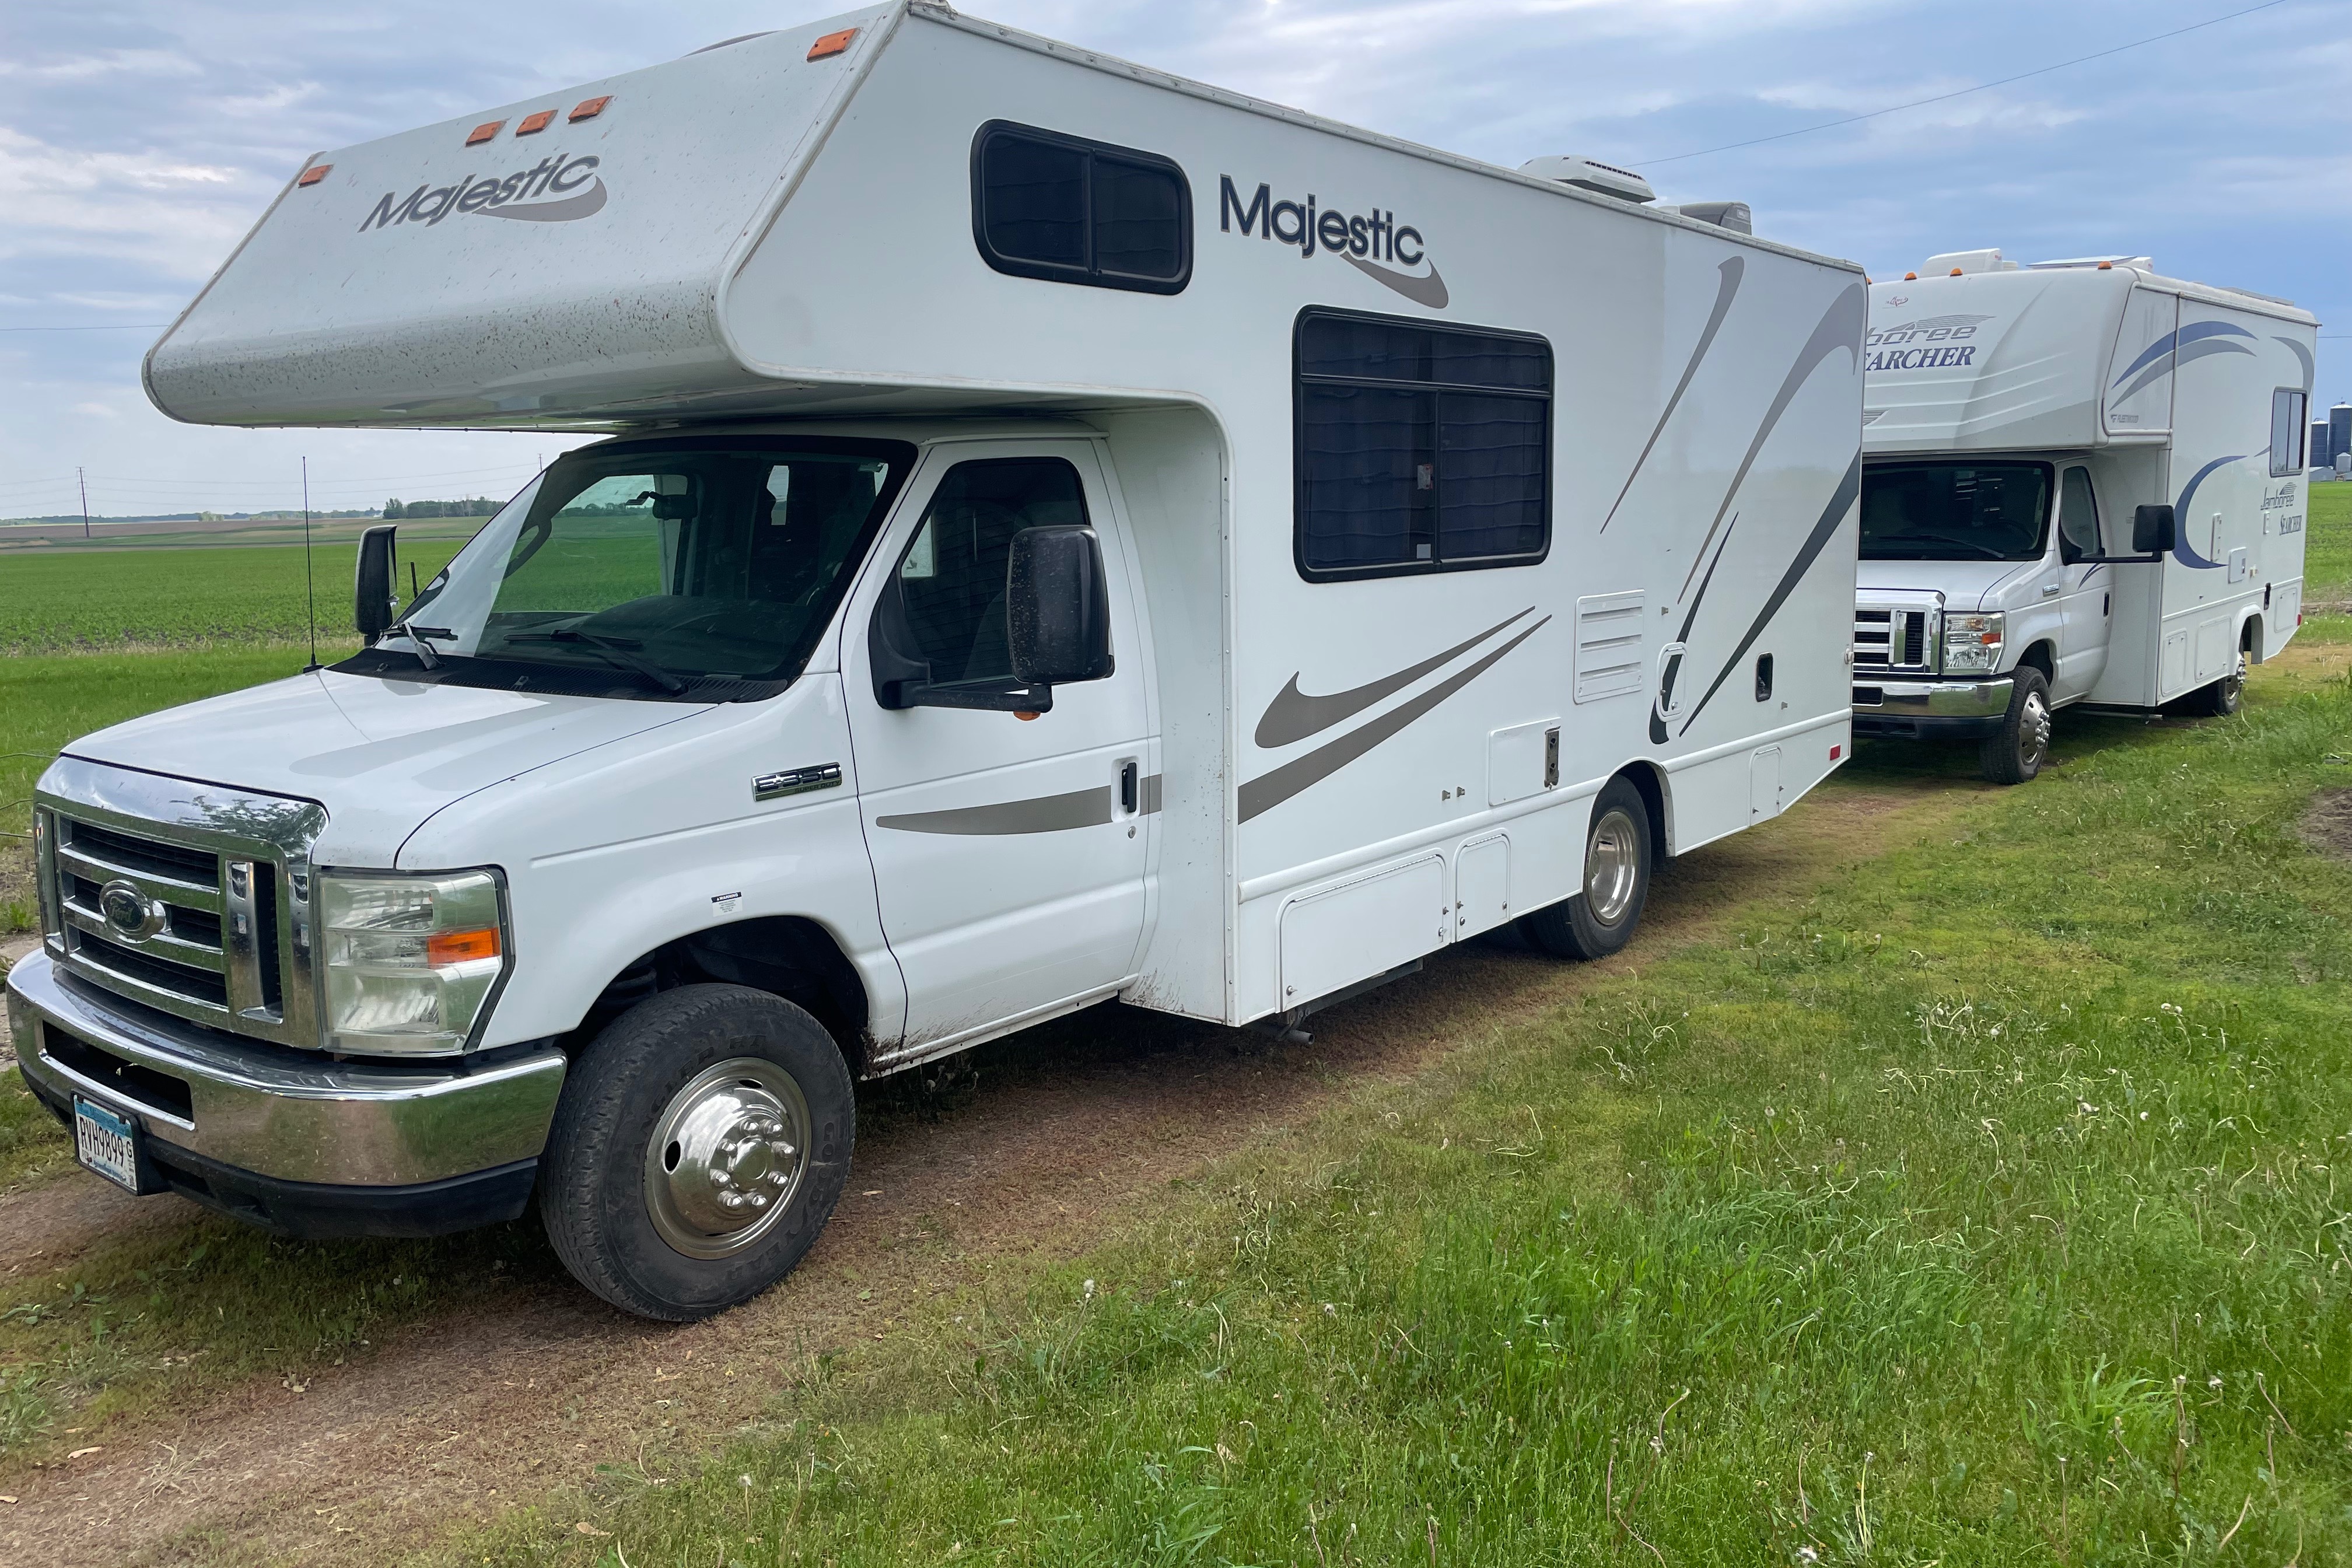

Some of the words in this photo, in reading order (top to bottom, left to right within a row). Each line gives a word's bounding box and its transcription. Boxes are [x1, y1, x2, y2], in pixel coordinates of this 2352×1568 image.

[357, 152, 600, 233] Majestic
[1220, 173, 1424, 266] Majestic
[794, 785, 819, 794] SUPER
[820, 780, 841, 789] DUTY
[79, 1116, 124, 1168] RVH9899
[126, 1140, 133, 1158] G
